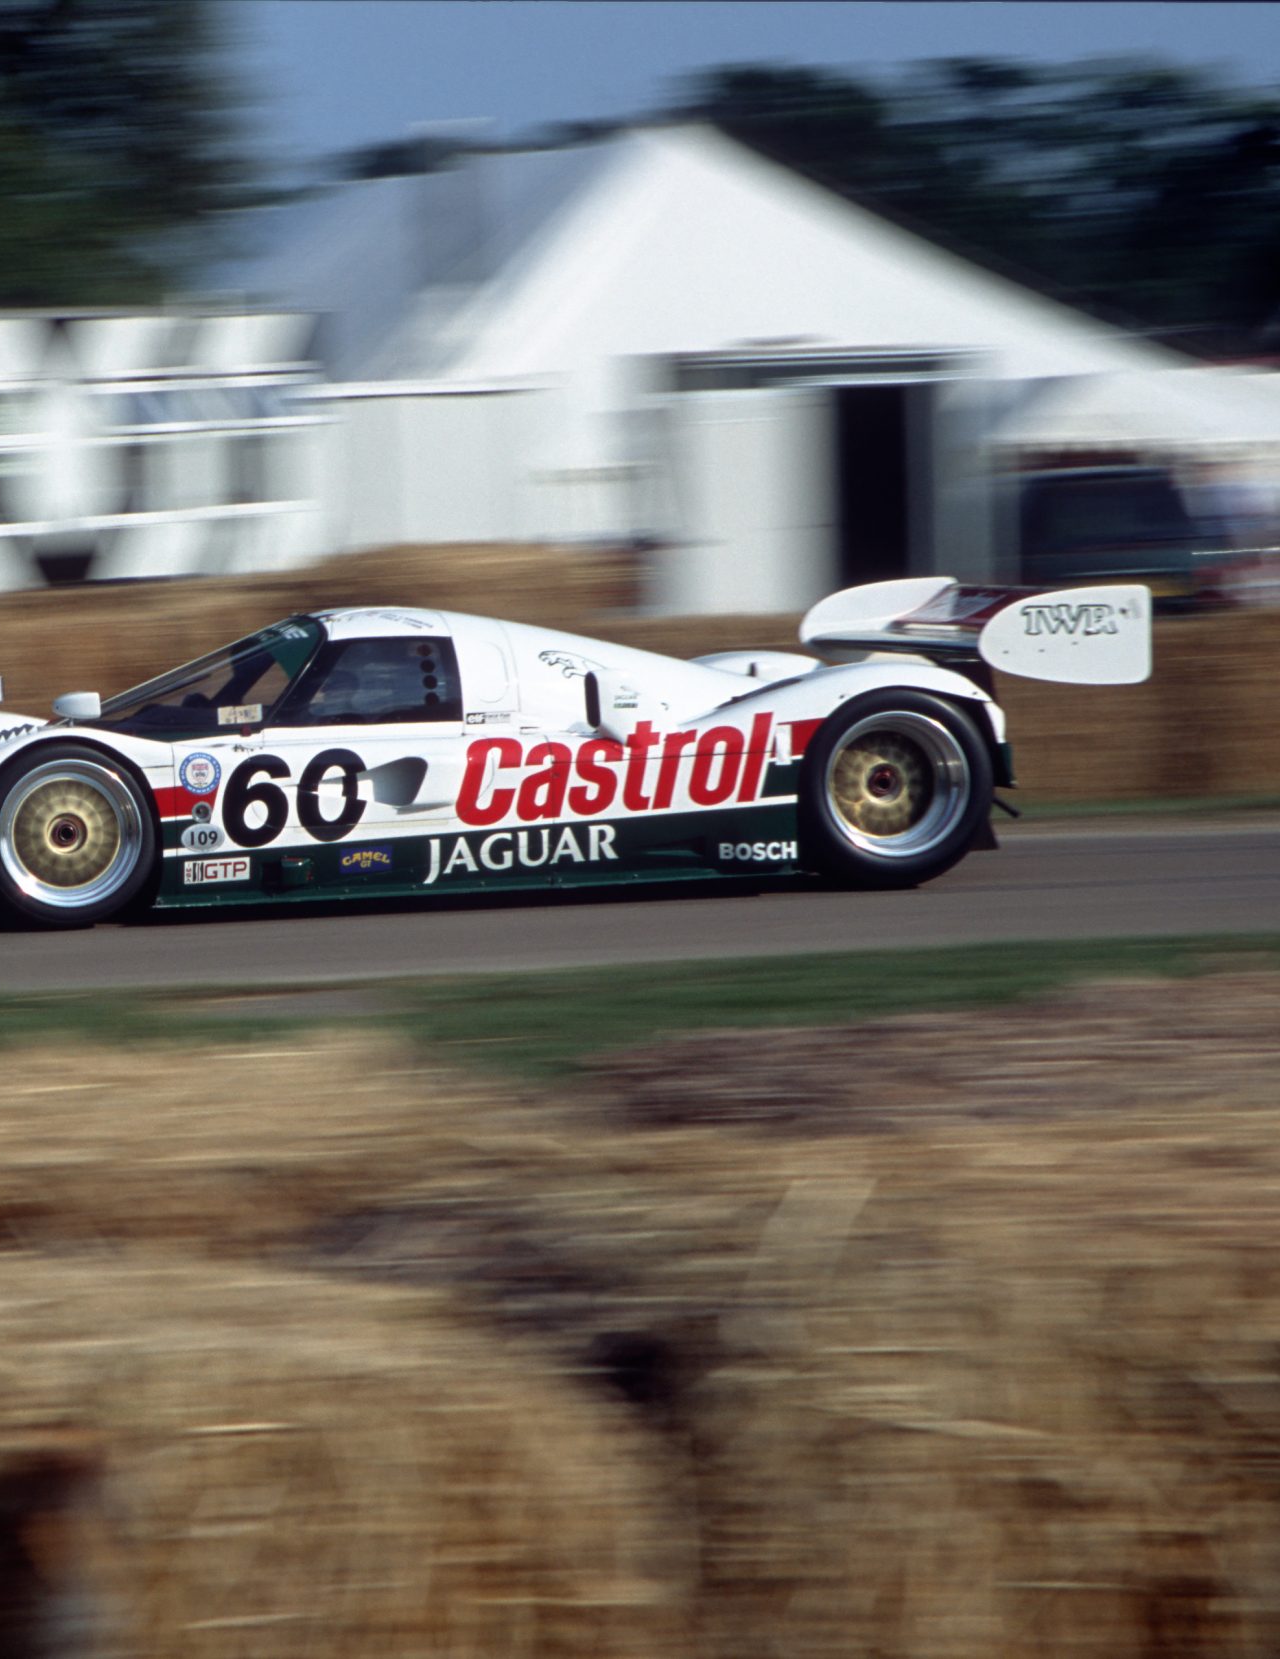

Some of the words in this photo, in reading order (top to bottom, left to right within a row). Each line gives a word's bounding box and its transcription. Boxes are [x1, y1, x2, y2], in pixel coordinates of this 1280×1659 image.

[1021, 603, 1118, 635] TWR
[456, 712, 774, 826] Castrol
[222, 748, 368, 848] 60
[190, 830, 218, 846] 109
[342, 851, 390, 866] CAMEL
[423, 824, 619, 885] JAGUAR
[718, 841, 798, 861] BOSCH
[205, 861, 247, 879] GTP
[360, 860, 371, 868] GT
